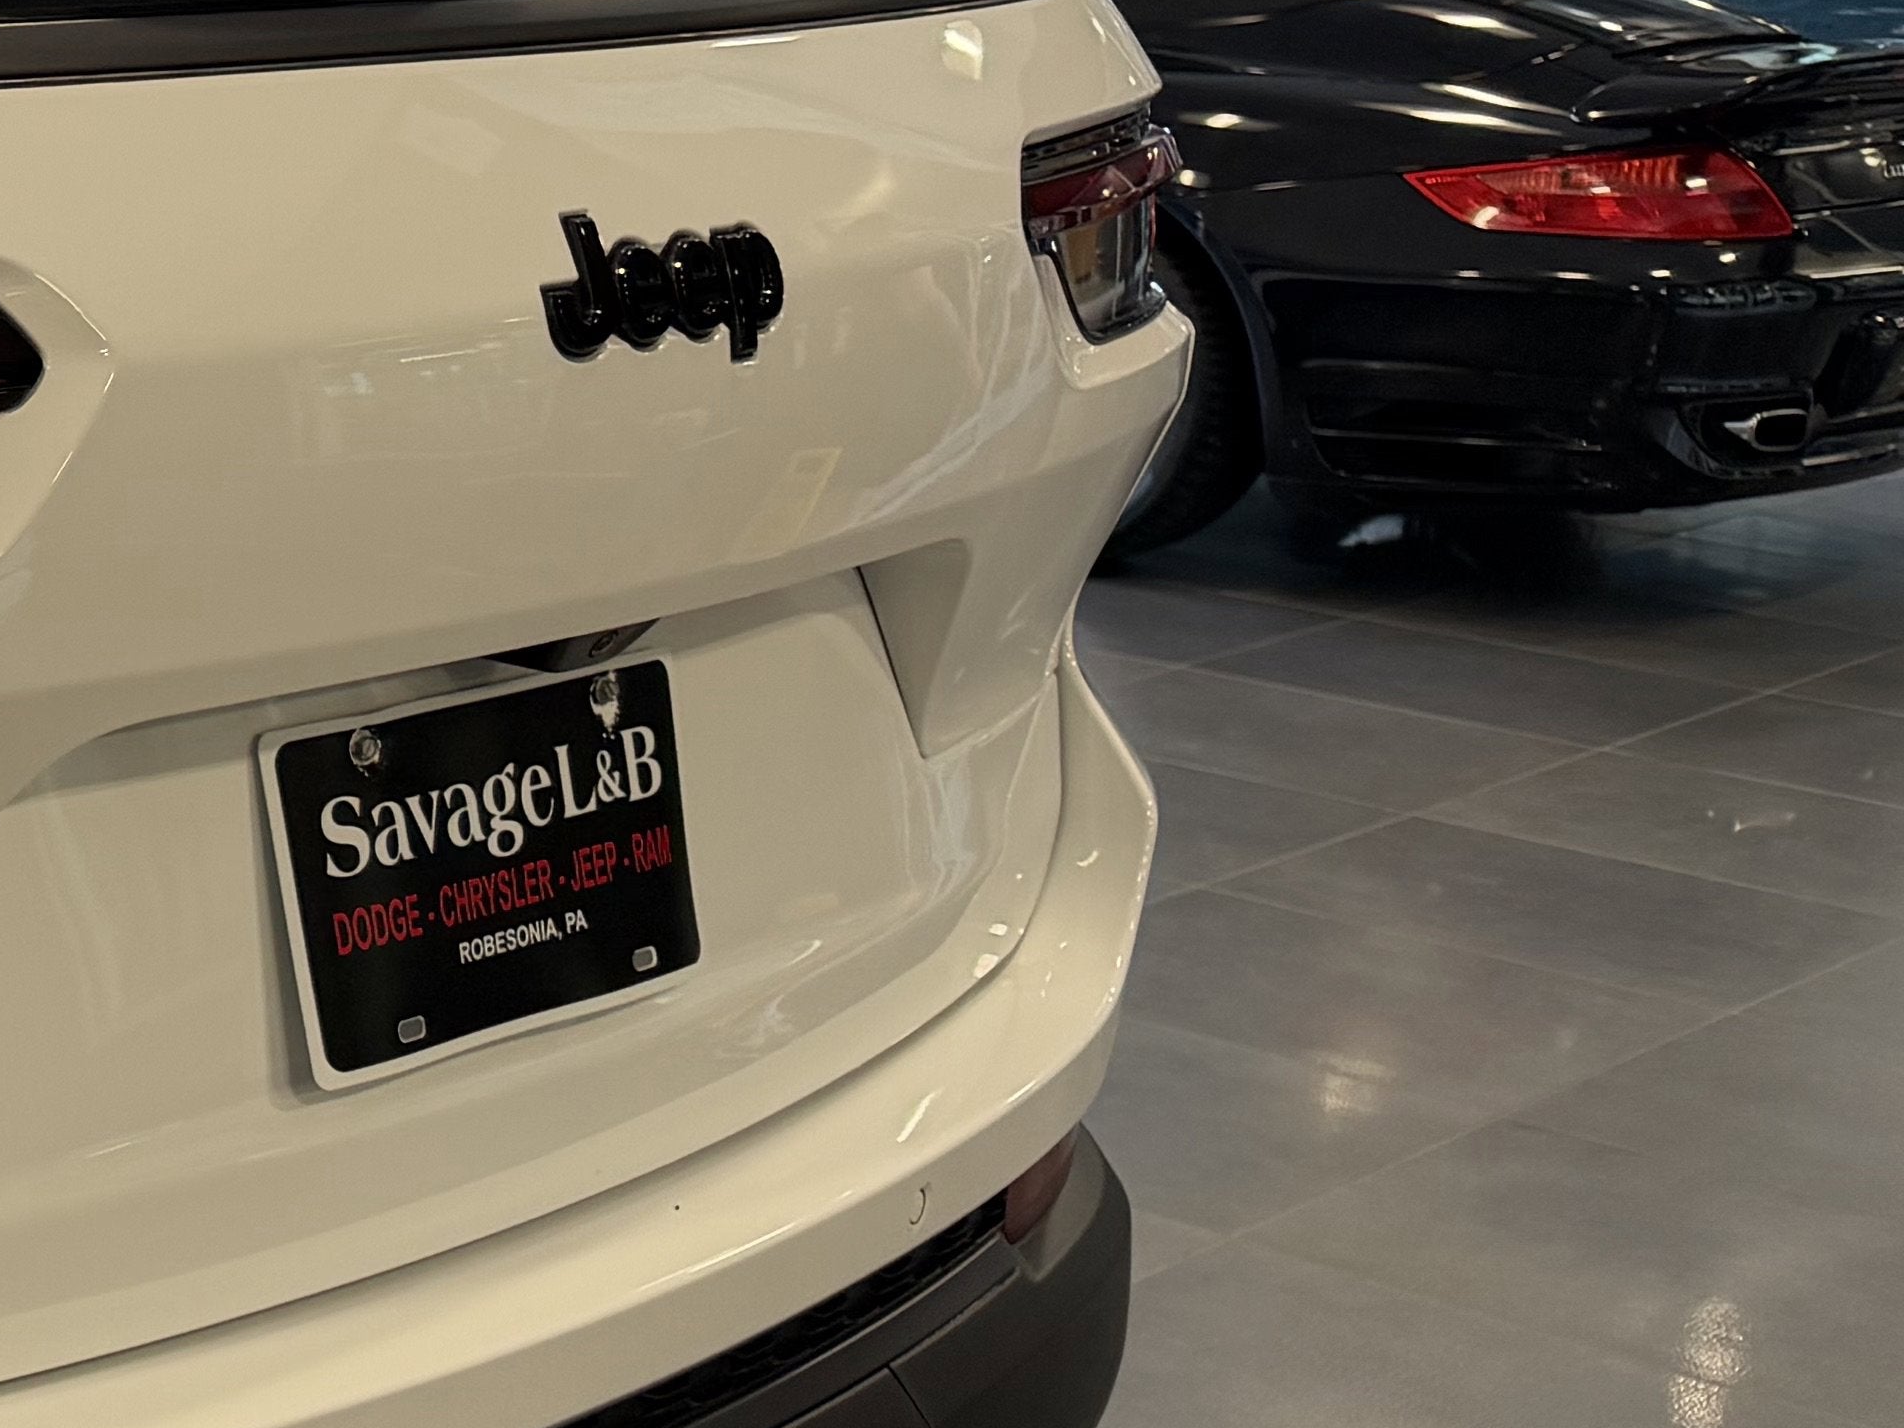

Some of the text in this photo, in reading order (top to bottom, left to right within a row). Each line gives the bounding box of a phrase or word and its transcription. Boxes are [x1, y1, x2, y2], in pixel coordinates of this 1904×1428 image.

[540, 210, 784, 363] Jeep
[320, 726, 662, 878] SavageL&B
[333, 825, 672, 956] DODGE CHRYSLER JEEP RAM
[459, 909, 589, 964] ROBESONIA, PA
